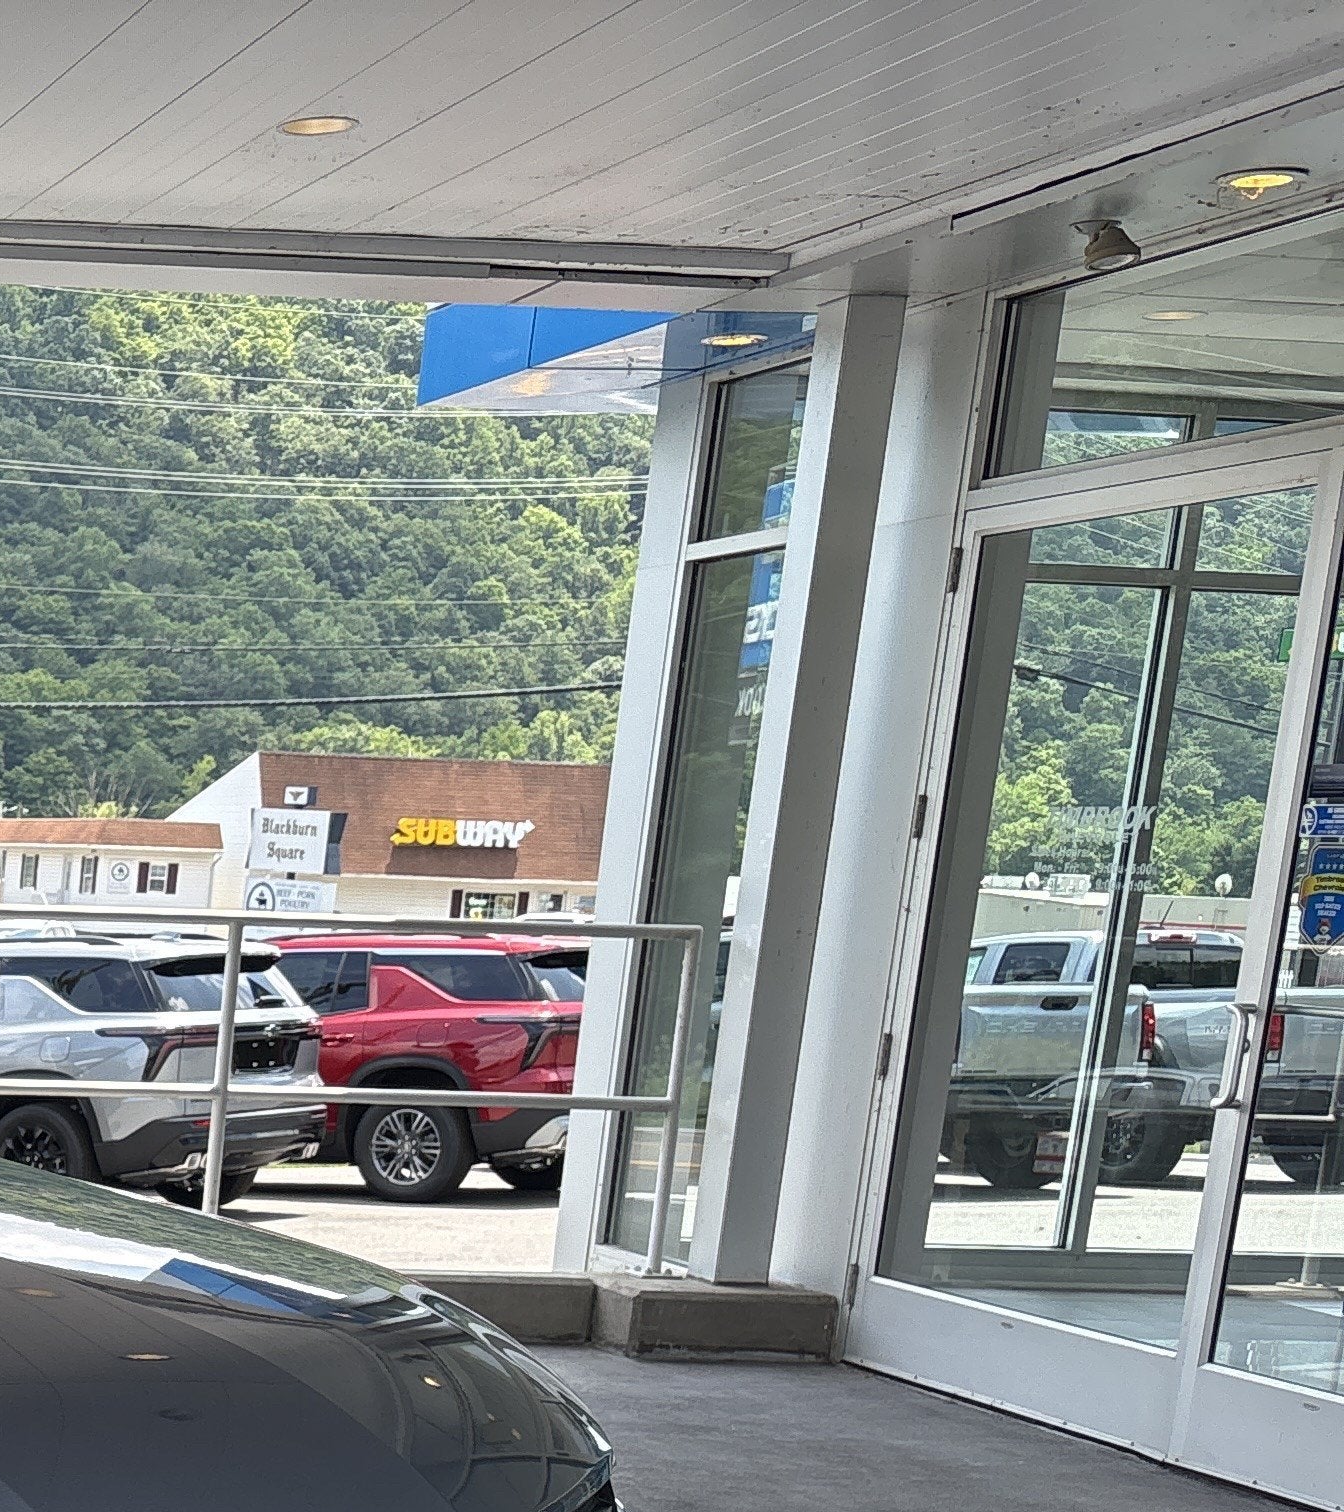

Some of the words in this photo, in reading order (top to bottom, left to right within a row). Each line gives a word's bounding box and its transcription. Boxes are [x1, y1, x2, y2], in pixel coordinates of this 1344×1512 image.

[261, 816, 318, 837] Blackburn
[390, 817, 536, 848] SUBWAY
[266, 841, 306, 862] Square
